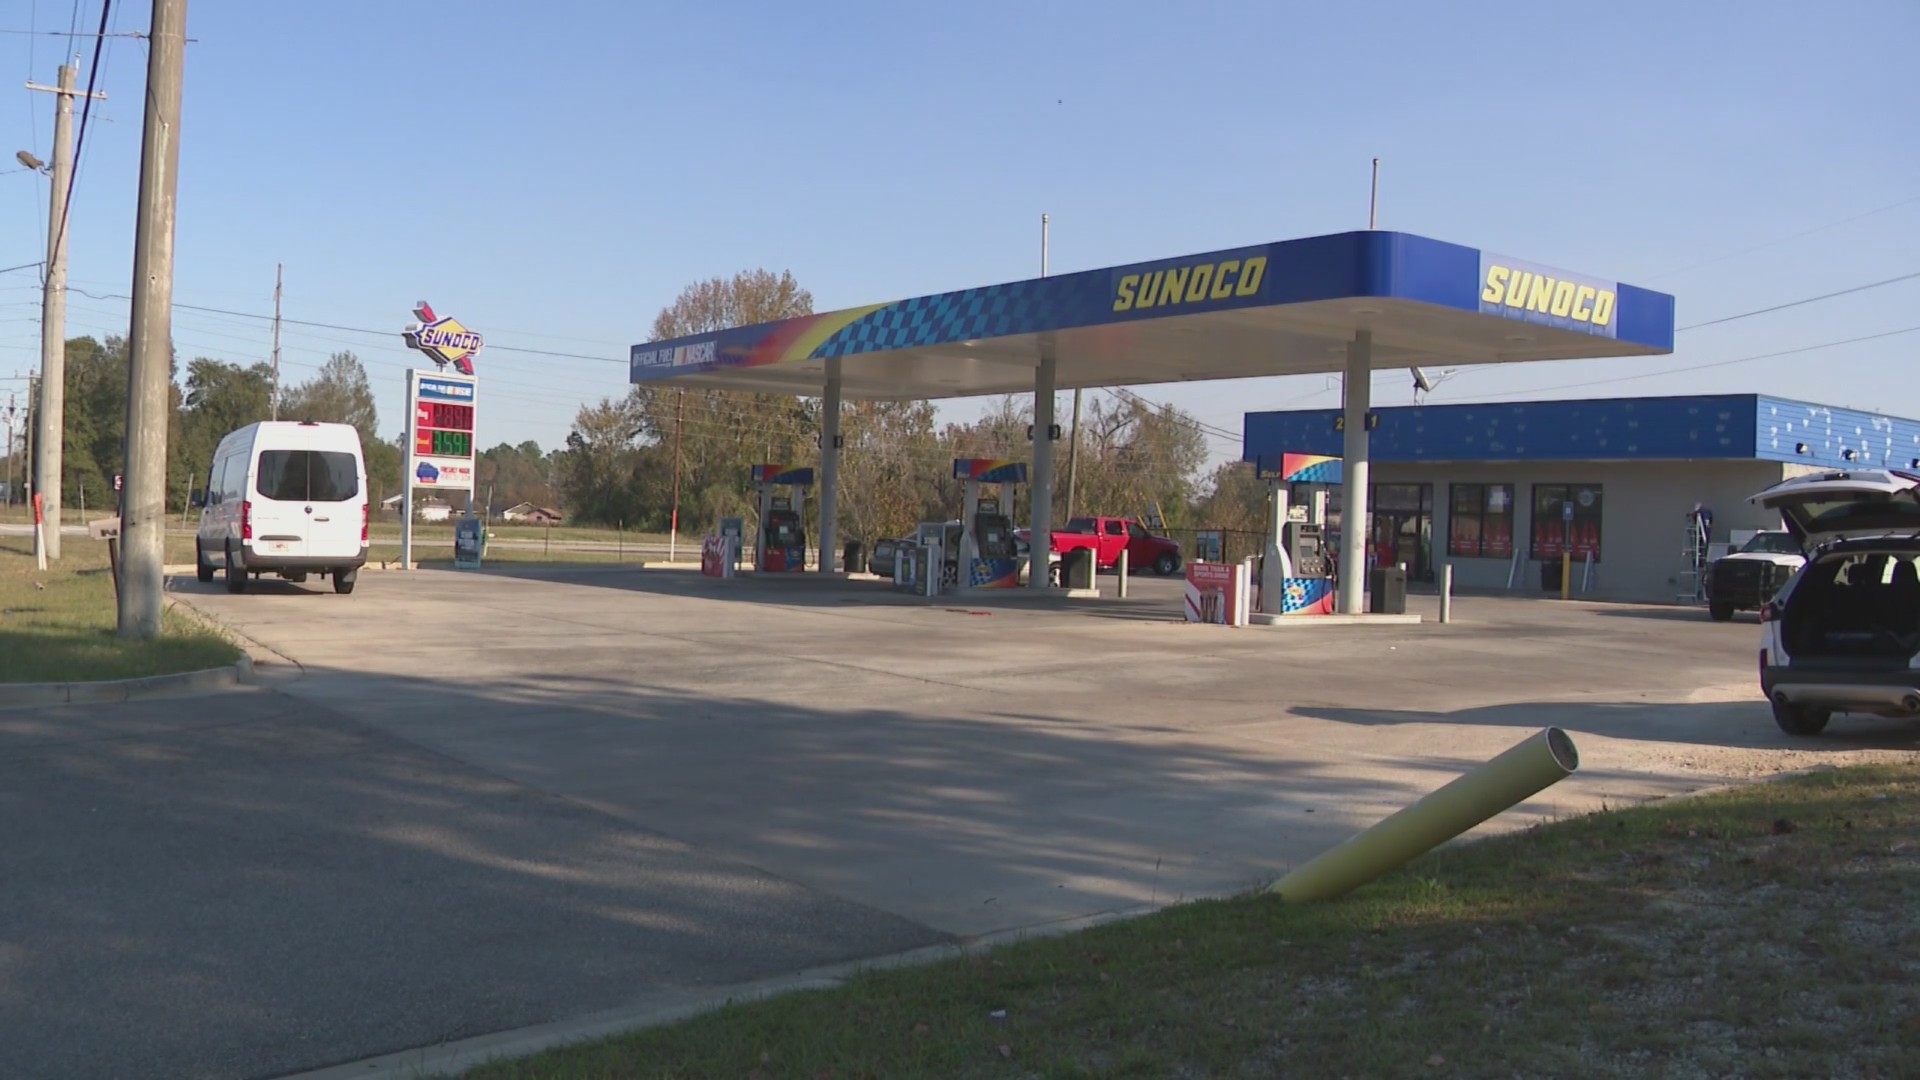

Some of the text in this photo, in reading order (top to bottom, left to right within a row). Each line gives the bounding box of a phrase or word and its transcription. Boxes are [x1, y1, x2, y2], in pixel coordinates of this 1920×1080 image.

[1113, 255, 1268, 312] SUNOCO
[1481, 264, 1616, 326] SUNOCO
[424, 329, 480, 350] SUNOCO
[633, 341, 716, 367] OFFICIAL FUEL NASCAR
[1336, 417, 1344, 430] 2
[1370, 415, 1377, 427] 1
